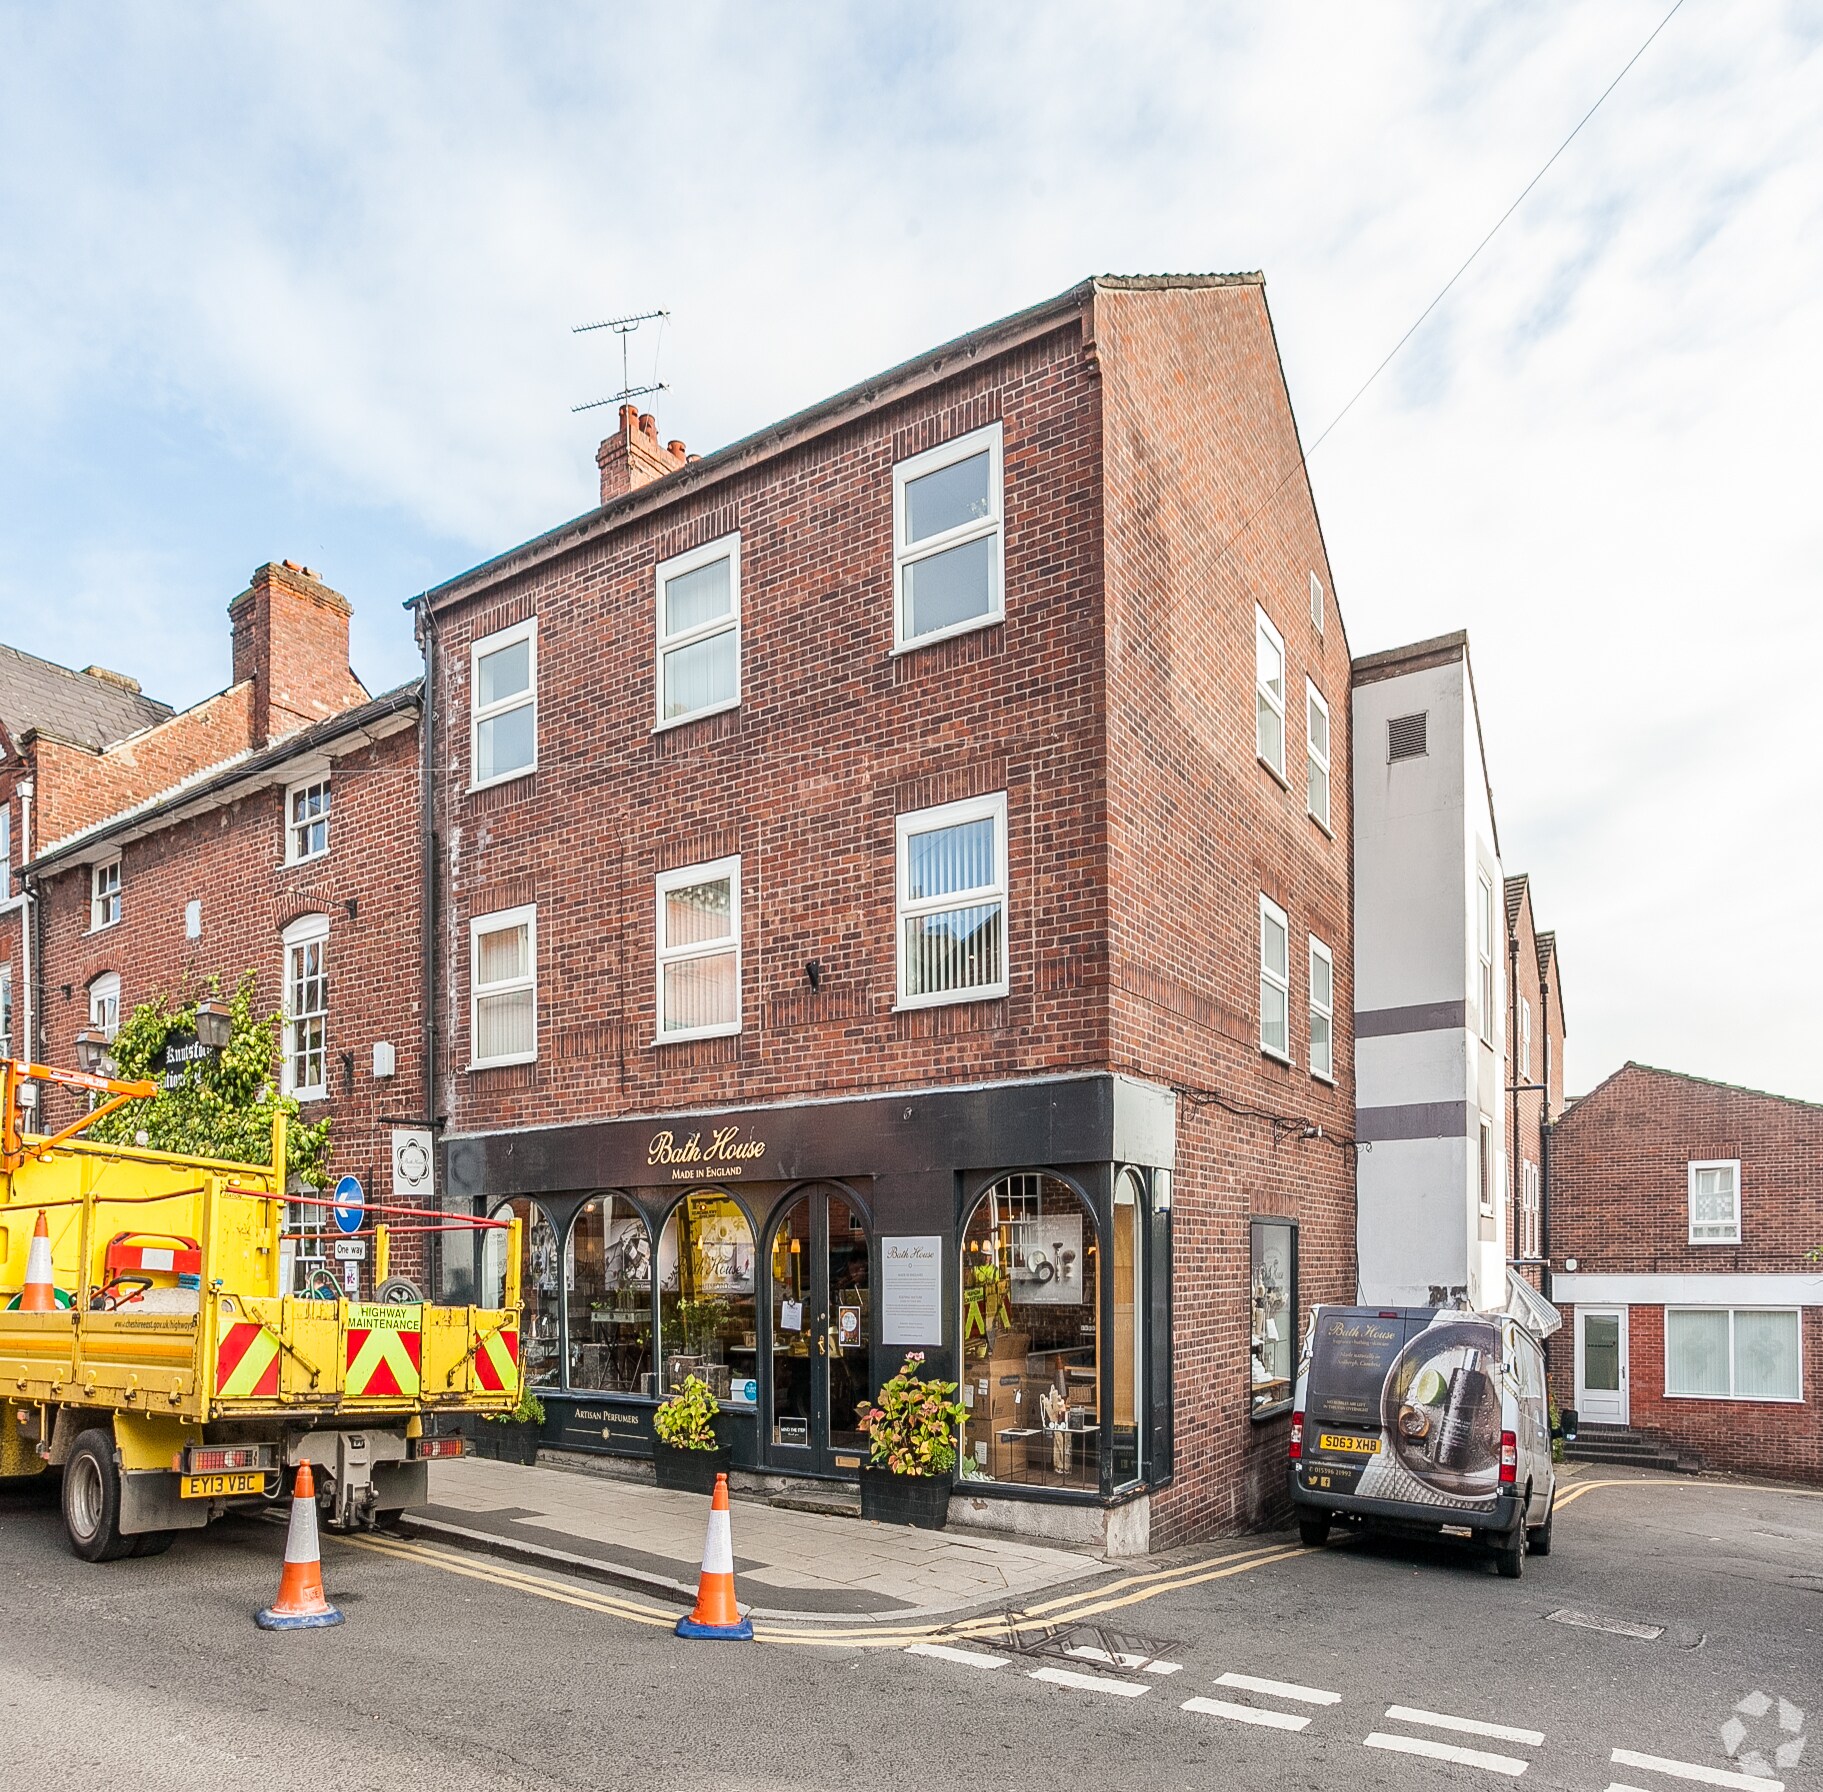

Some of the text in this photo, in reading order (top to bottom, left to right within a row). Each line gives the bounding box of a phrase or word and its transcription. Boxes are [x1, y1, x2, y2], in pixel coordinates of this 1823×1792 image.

[648, 1126, 766, 1165] Bath House
[672, 1166, 742, 1179] MADE IN ENGLAND
[337, 1244, 363, 1256] One way
[887, 1246, 935, 1259] Bath House
[673, 1255, 742, 1275] Bath House
[361, 1307, 407, 1318] HIGHWAY
[347, 1318, 419, 1329] MAINTENANCE
[1328, 1322, 1396, 1340] Bath House
[575, 1408, 639, 1424] ARTISAN PERFUMERS
[1325, 1436, 1377, 1451] SD63 XHB
[190, 1475, 255, 1494] EY13 VBC
